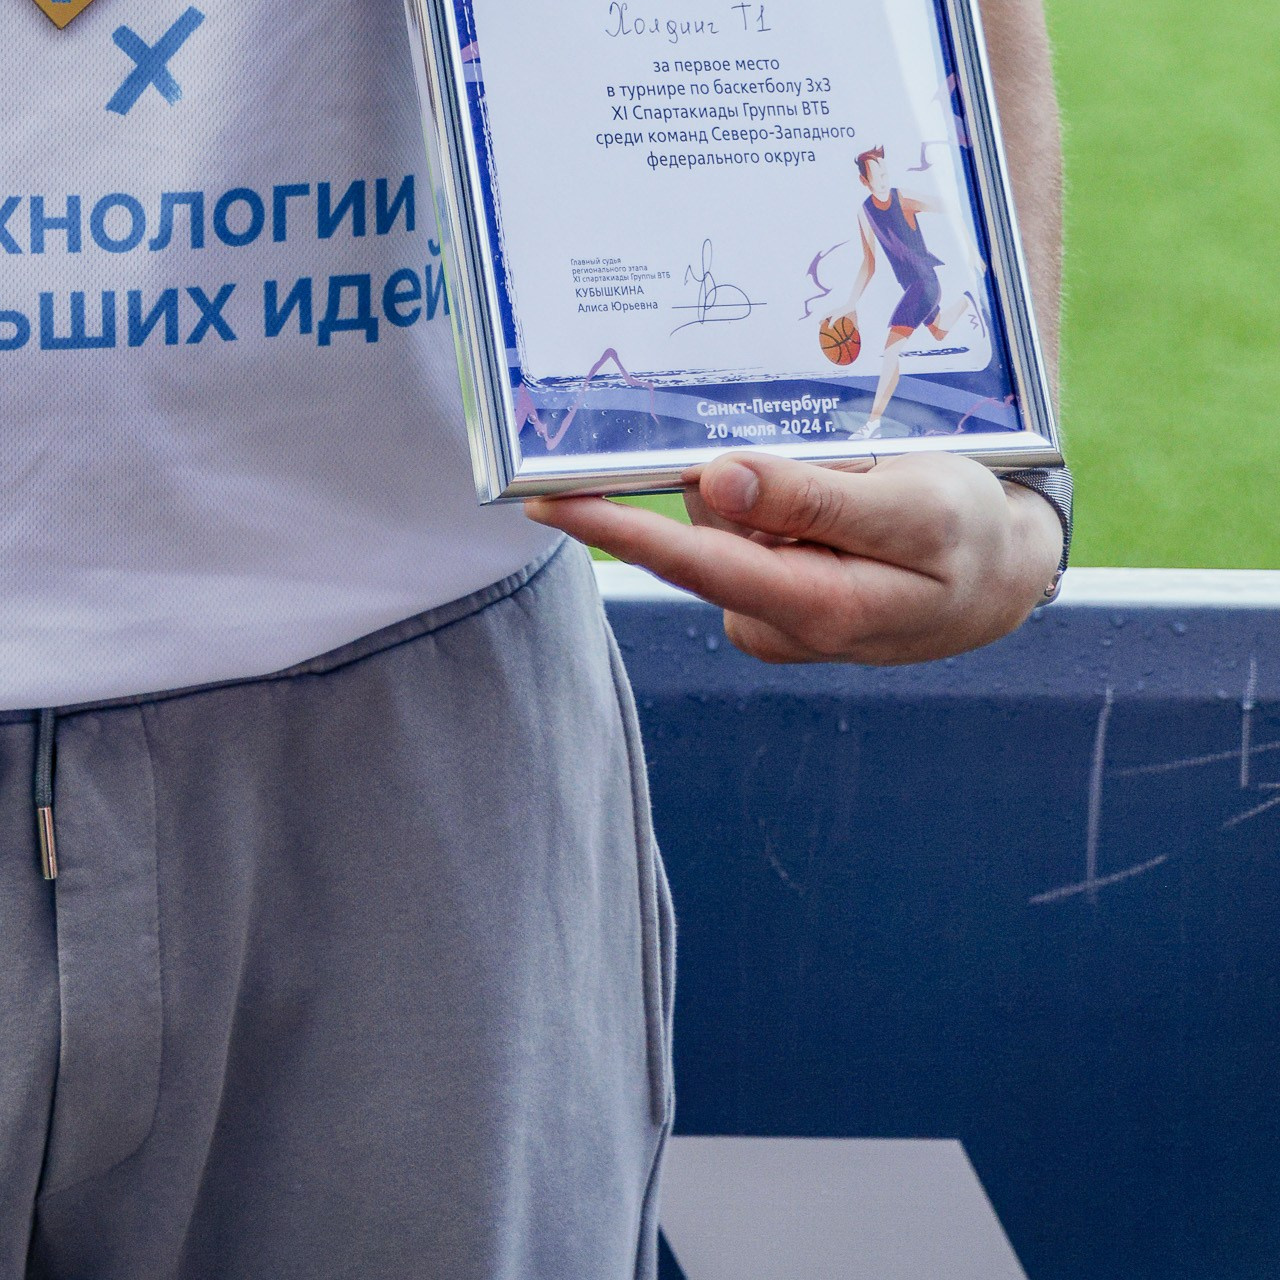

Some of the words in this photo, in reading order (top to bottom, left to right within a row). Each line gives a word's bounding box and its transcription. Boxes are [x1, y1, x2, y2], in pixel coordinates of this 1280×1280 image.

[605, 1, 720, 44] Холдинг
[653, 60, 670, 72] за
[674, 58, 731, 75] первое
[736, 57, 780, 71] место
[607, 86, 616, 97] в
[619, 83, 686, 102] турнире
[690, 82, 710, 96] по
[713, 77, 802, 97] баскетболу
[611, 105, 628, 121] XI
[632, 104, 739, 123] Спартакиады
[742, 102, 798, 121] Группы
[801, 100, 830, 116] ВТБ
[596, 130, 644, 149] среди
[648, 128, 709, 145] команд
[711, 124, 856, 144] Северо-Западного
[646, 150, 760, 171] федерального
[764, 148, 816, 168] округа
[570, 257, 601, 266] Главный
[602, 258, 622, 267] судья
[572, 266, 627, 276] регионального
[628, 265, 648, 273] этапа
[582, 274, 629, 284] спартакиады
[630, 272, 656, 282] Группы
[657, 271, 671, 280] ВТБ
[261, 239, 451, 347] идей
[575, 285, 645, 298] КУБЫШКИНА
[577, 302, 609, 313] Алиса
[611, 301, 658, 313] Юрьевна
[696, 394, 840, 417] Санкт-Петербург
[706, 423, 728, 439] 20
[731, 423, 776, 438] июля
[780, 418, 822, 435] 2024
[825, 420, 836, 433] г.
